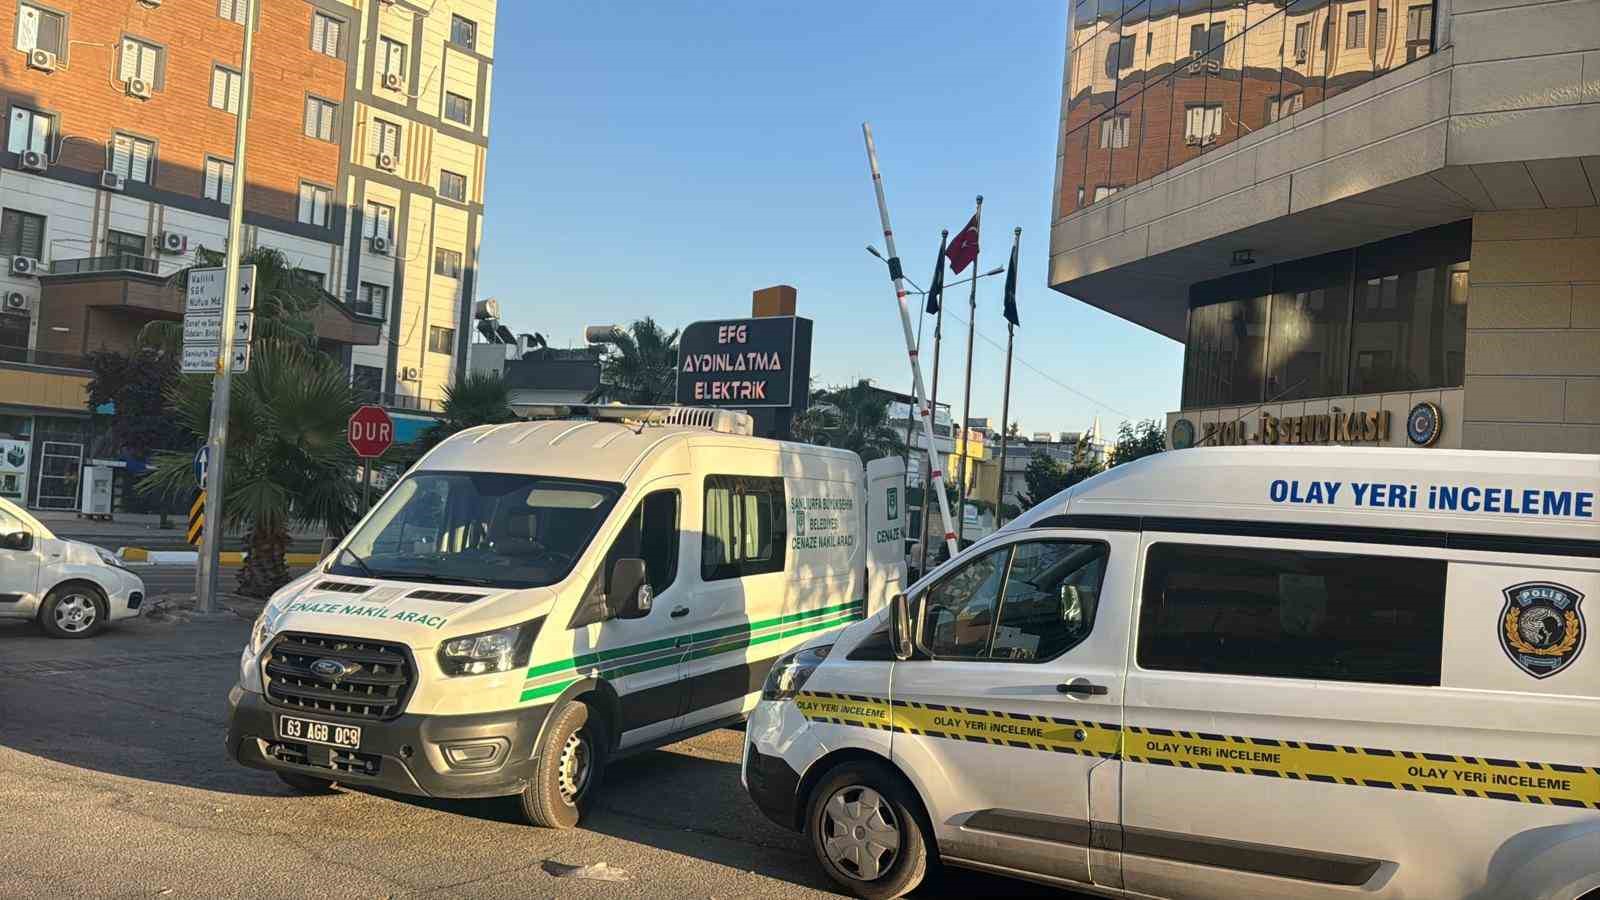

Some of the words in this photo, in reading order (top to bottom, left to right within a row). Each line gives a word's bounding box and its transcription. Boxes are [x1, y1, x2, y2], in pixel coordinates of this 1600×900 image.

[718, 324, 747, 344] EFG
[682, 351, 782, 373] AYDINLATMA
[352, 421, 390, 442] DUR
[1269, 479, 1342, 505] OLAY
[792, 536, 817, 550] CENAZE
[877, 528, 900, 544] CENAZE
[284, 601, 341, 614] ENAZE
[391, 610, 448, 630] ARACI
[796, 700, 818, 711] OLAY
[287, 719, 301, 737] 63
[307, 722, 329, 741] AGB
[934, 716, 961, 727] OLAY
[1146, 741, 1180, 753] OLAY
[1408, 766, 1449, 779] OLAY
